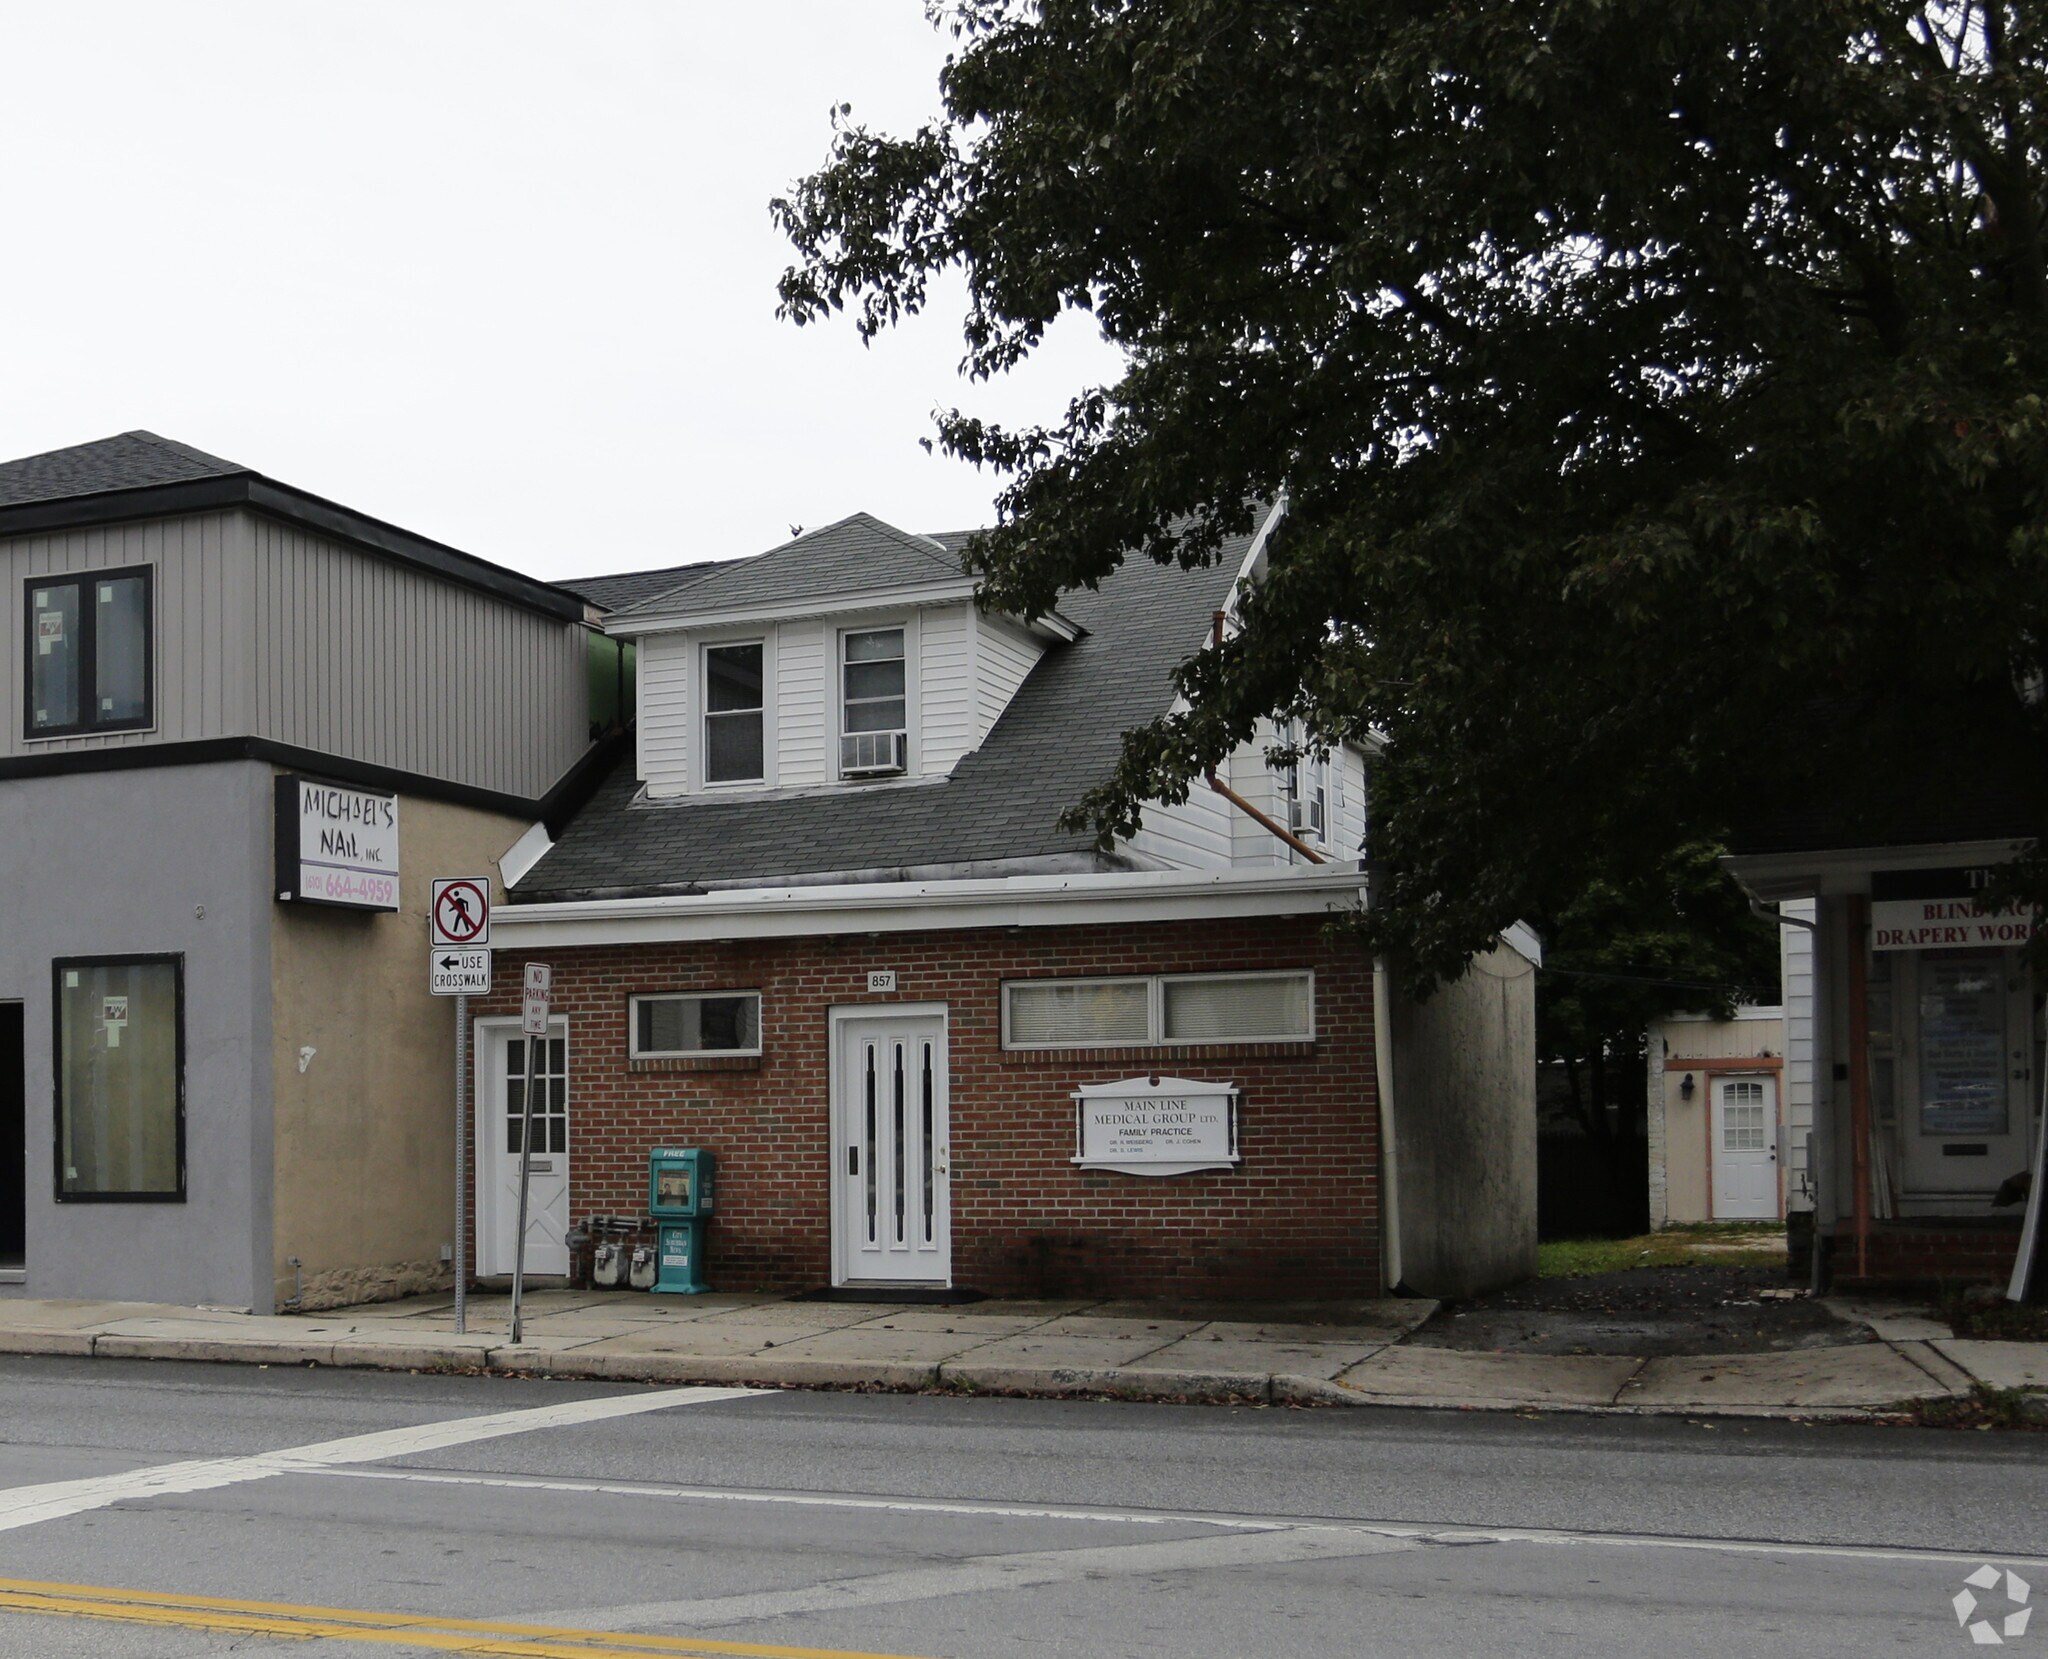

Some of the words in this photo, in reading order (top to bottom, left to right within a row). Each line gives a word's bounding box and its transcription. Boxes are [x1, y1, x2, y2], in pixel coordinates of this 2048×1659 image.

[325, 873, 393, 903] 664-4959
[1876, 925, 1970, 945] DRAPERY
[461, 956, 483, 969] USE
[434, 973, 487, 988] CROSSWALK
[533, 969, 543, 984] NO
[872, 975, 891, 987] 857
[526, 988, 549, 1001] PARKING
[532, 1006, 541, 1014] ANY
[531, 1020, 541, 1029] TIME
[1124, 1100, 1156, 1111] MAIN
[1160, 1100, 1187, 1111] LINE
[1094, 1114, 1149, 1125] MEDICAL
[1152, 1113, 1196, 1124] GROUP
[1118, 1128, 1147, 1136] FAMILY
[1150, 1127, 1193, 1136] PRACTICE
